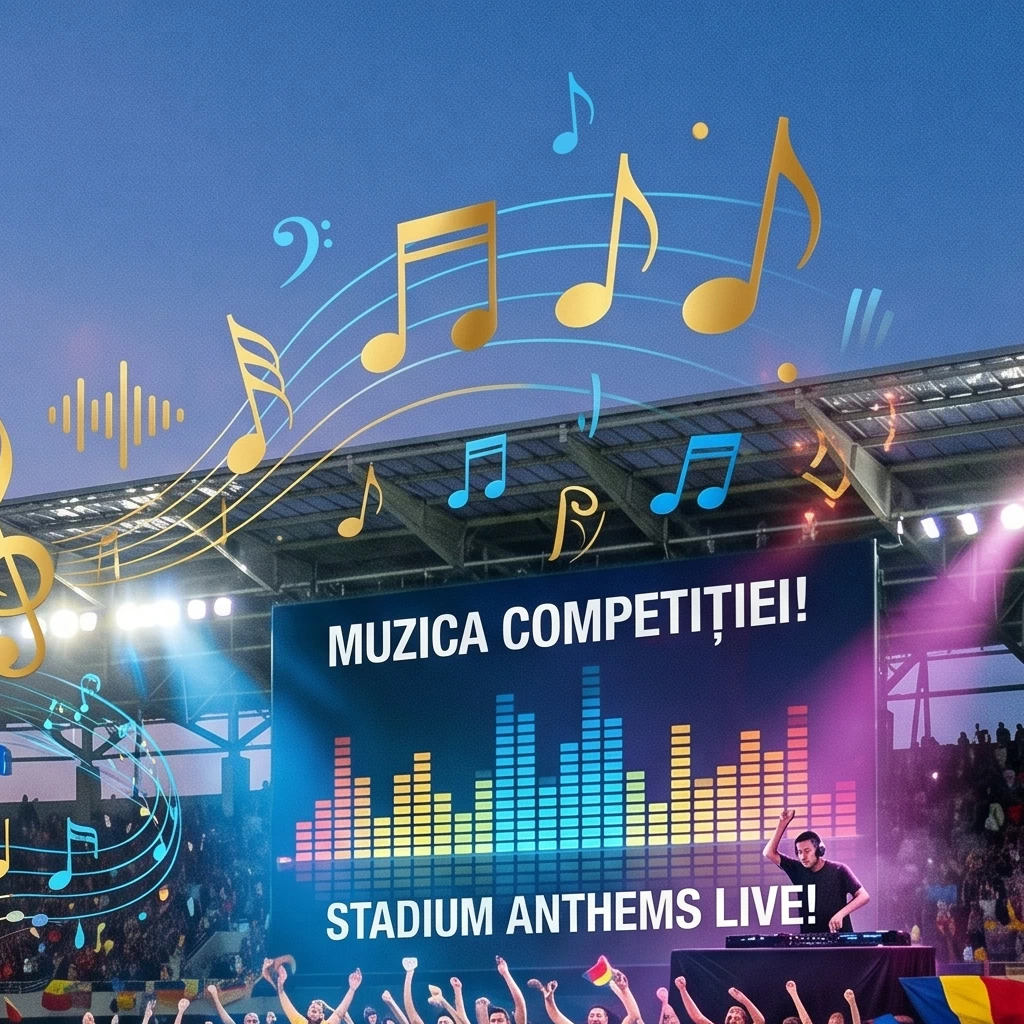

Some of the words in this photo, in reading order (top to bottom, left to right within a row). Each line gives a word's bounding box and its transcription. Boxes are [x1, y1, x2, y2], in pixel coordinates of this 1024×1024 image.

[328, 611, 489, 668] MUZICA
[503, 576, 808, 651] COMPETIȚIEI!
[326, 897, 494, 941] STADIUM
[506, 887, 702, 935] ANTHEMS
[716, 884, 817, 928] LIVE!
